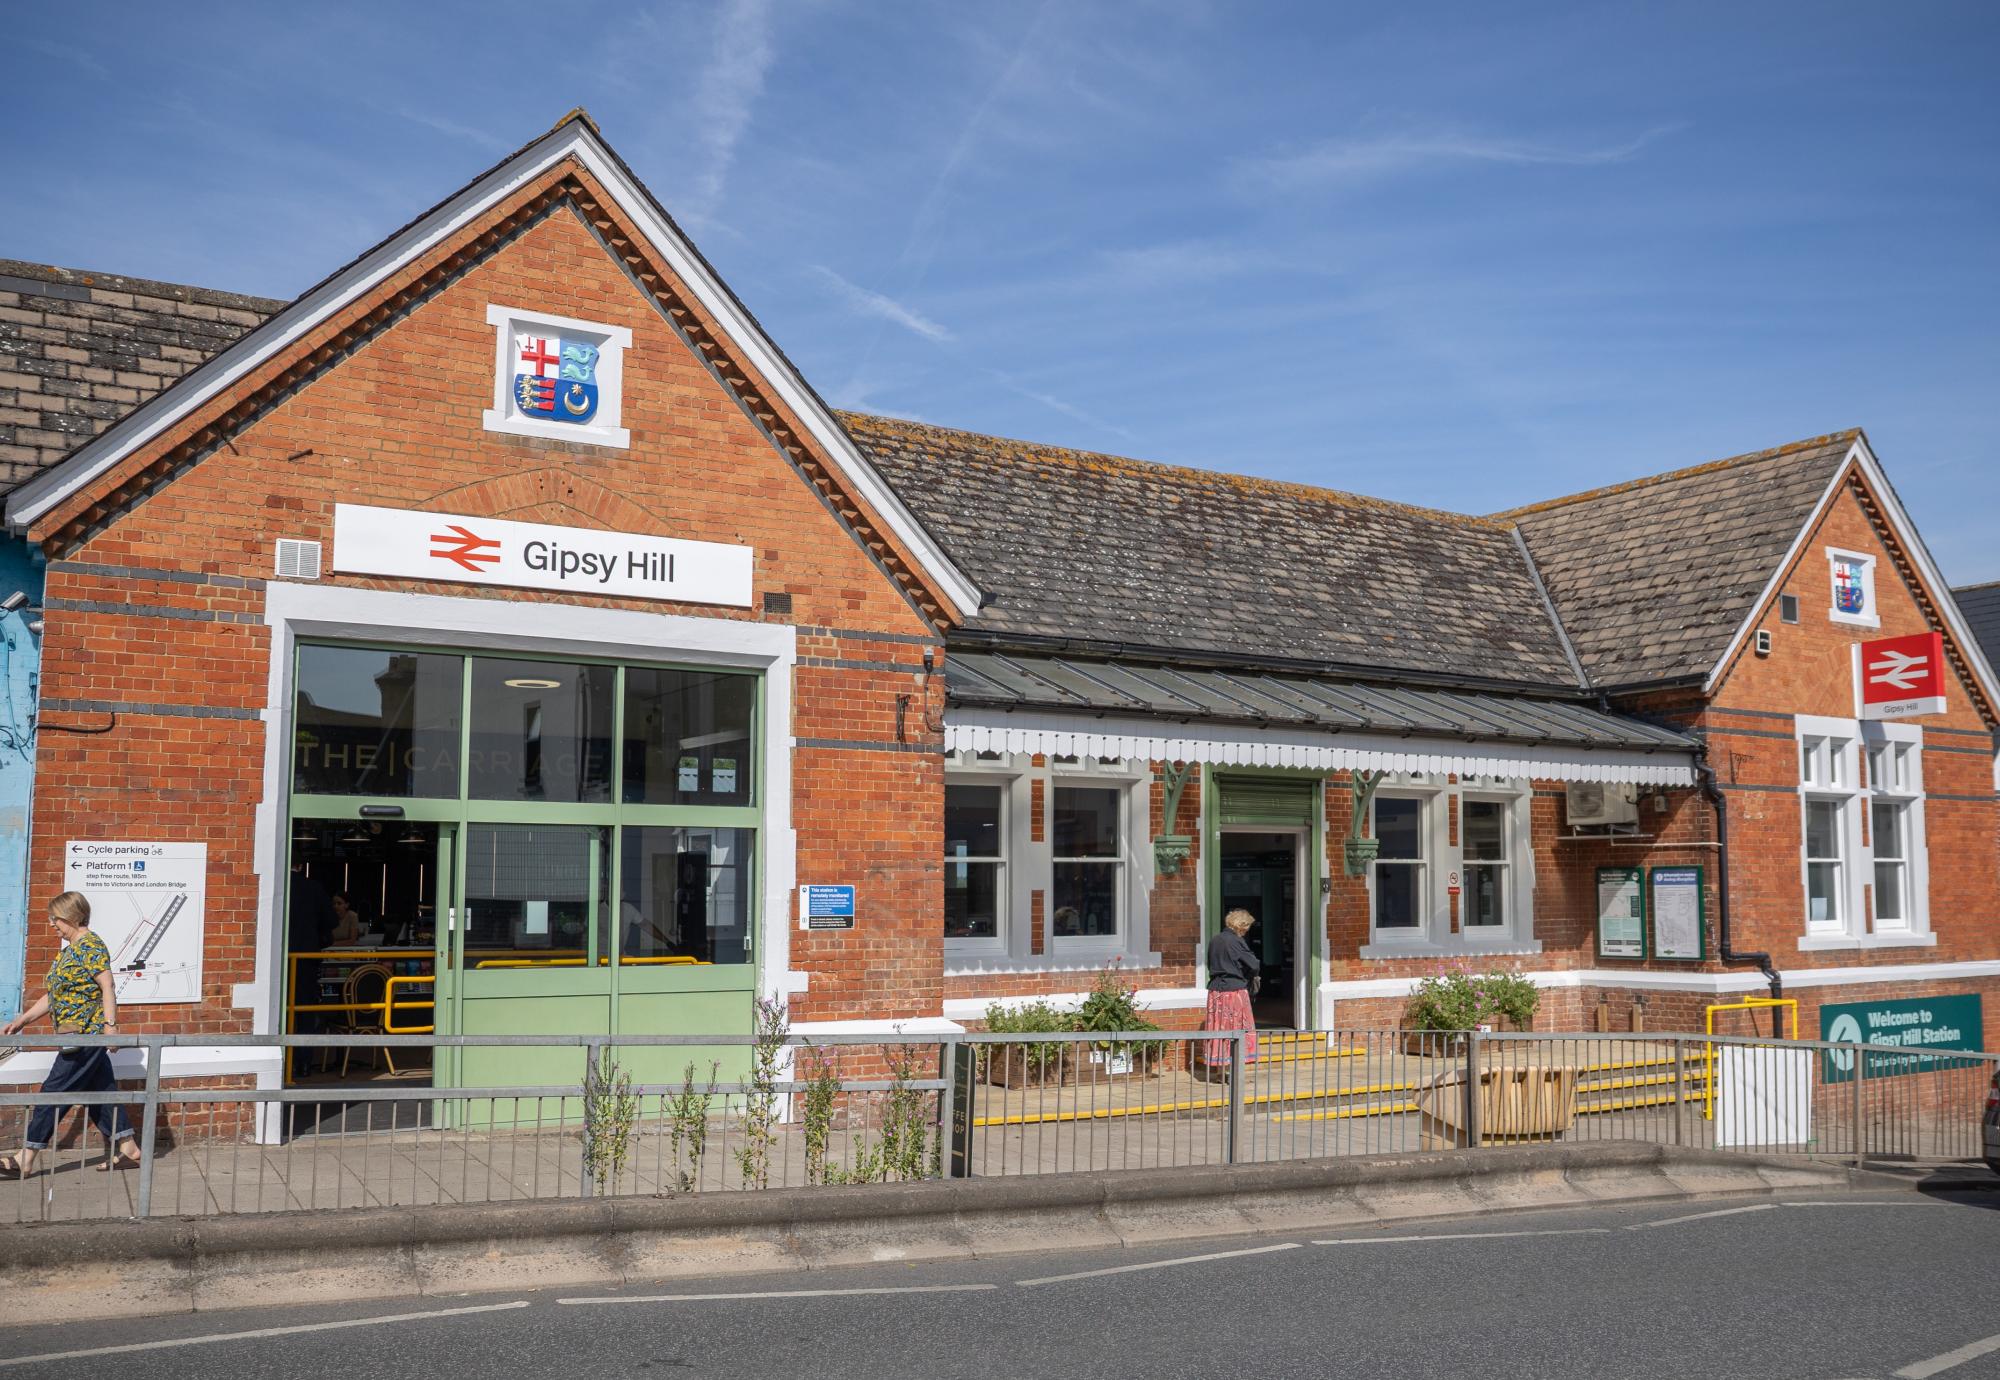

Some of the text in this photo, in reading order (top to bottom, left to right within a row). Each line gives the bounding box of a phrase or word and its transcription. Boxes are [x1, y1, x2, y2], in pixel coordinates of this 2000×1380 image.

[523, 540, 675, 583] Gipsy Hill
[1884, 705, 1904, 713] Gipsy
[296, 741, 604, 777] THE CARRIAGE
[87, 845, 149, 855] Cycle parking
[86, 861, 132, 870] Platform 1
[1868, 1009, 1932, 1028] Welcome to
[1869, 1025, 1961, 1046] Gipsy Hill Station
